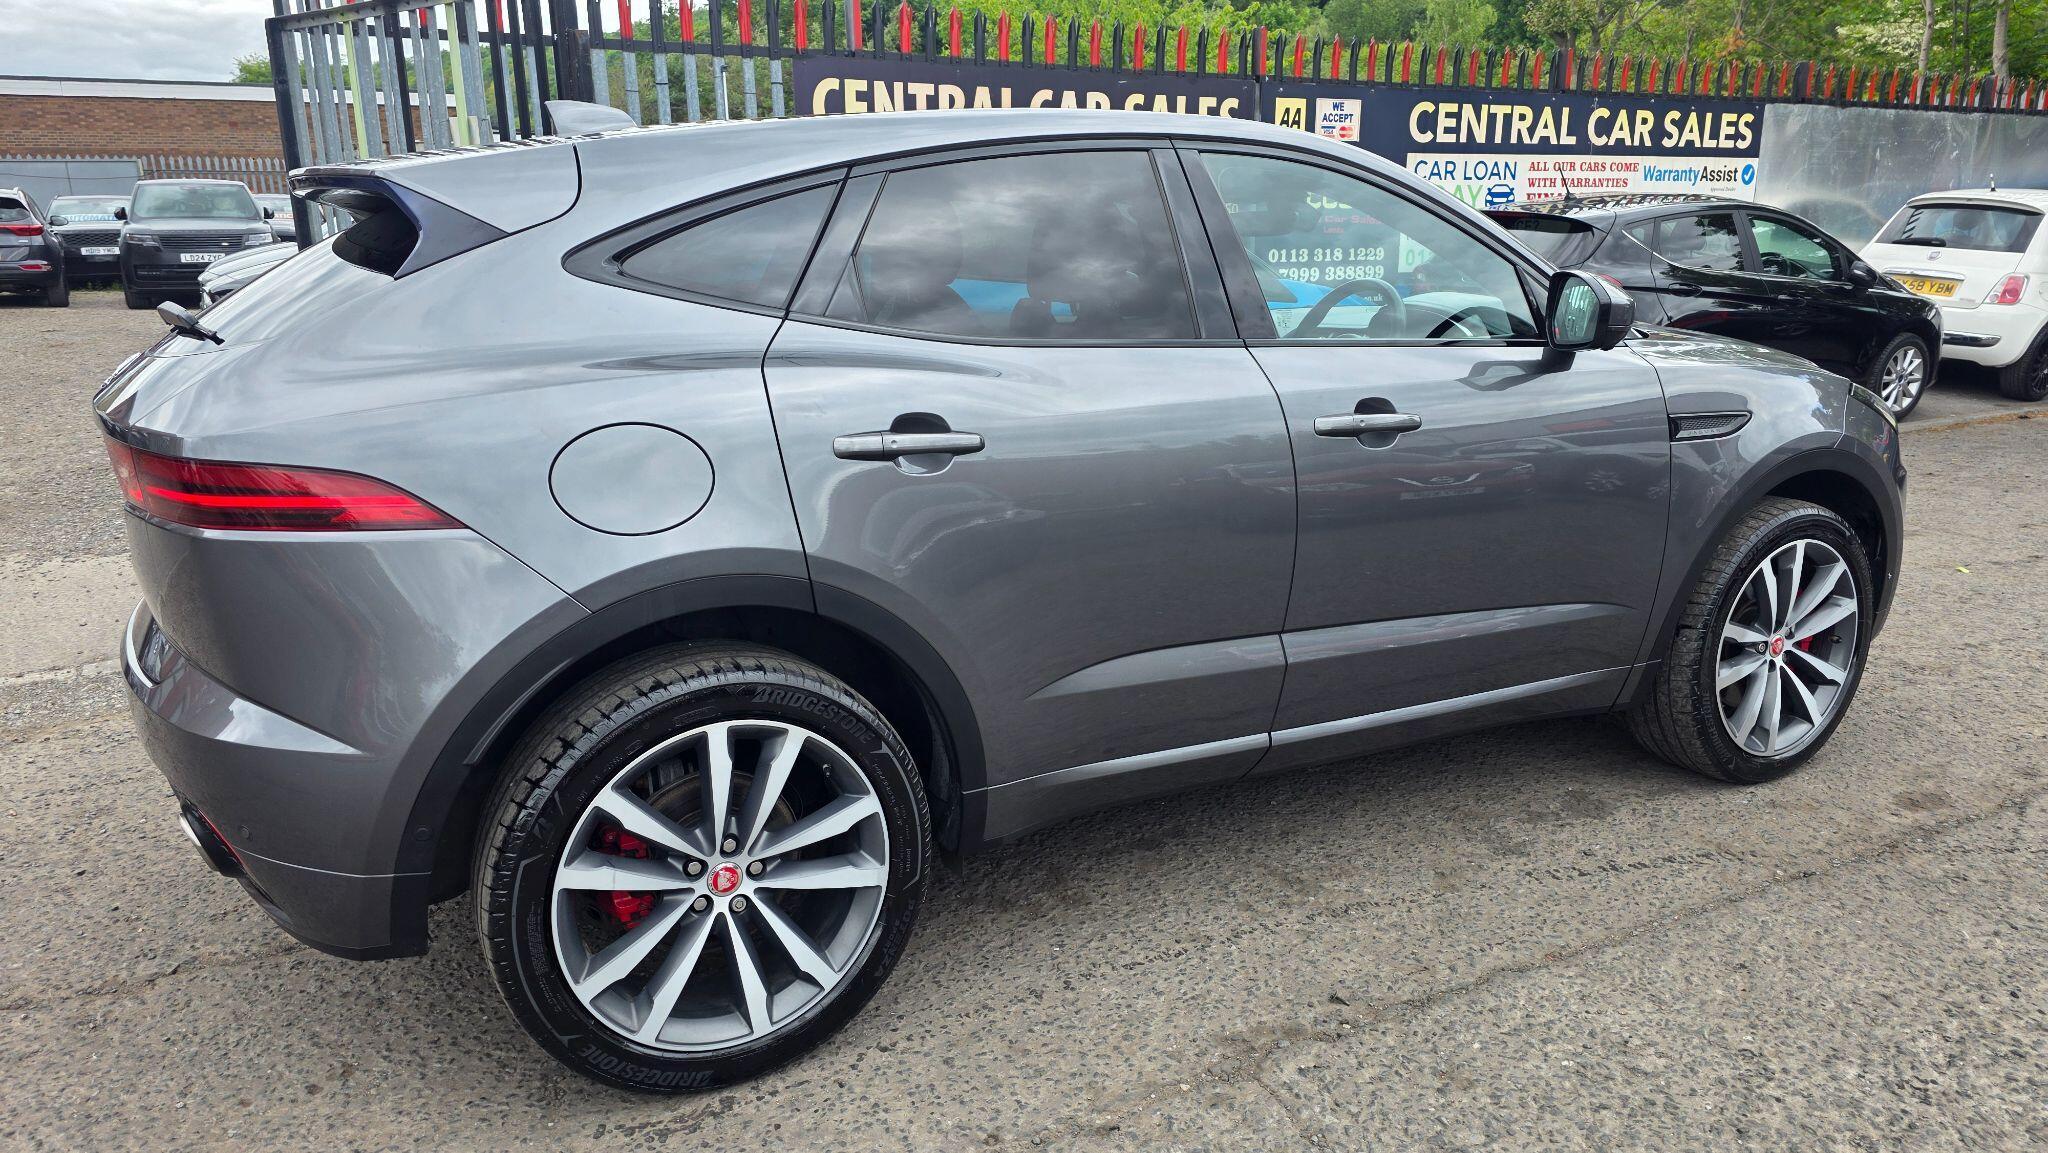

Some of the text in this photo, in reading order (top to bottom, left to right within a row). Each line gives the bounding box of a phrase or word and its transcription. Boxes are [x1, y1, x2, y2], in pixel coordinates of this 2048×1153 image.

[1332, 101, 1345, 112] WE
[1279, 107, 1302, 129] AA
[1321, 113, 1354, 123] ACCEPT
[1409, 101, 1755, 150] CENTRAL CAR SALES
[1414, 159, 1518, 181] CAR LOAN
[1528, 161, 1640, 173] ALL OUR CARS COME
[1527, 177, 1629, 188] WITH WARRANTIES
[1268, 247, 1385, 263] 0113 318 1229
[1325, 265, 1385, 281] 388899
[1928, 280, 1955, 294] YBM
[751, 685, 878, 744] BRIDGESTONE
[578, 1043, 715, 1088] BRIDGESTONE
